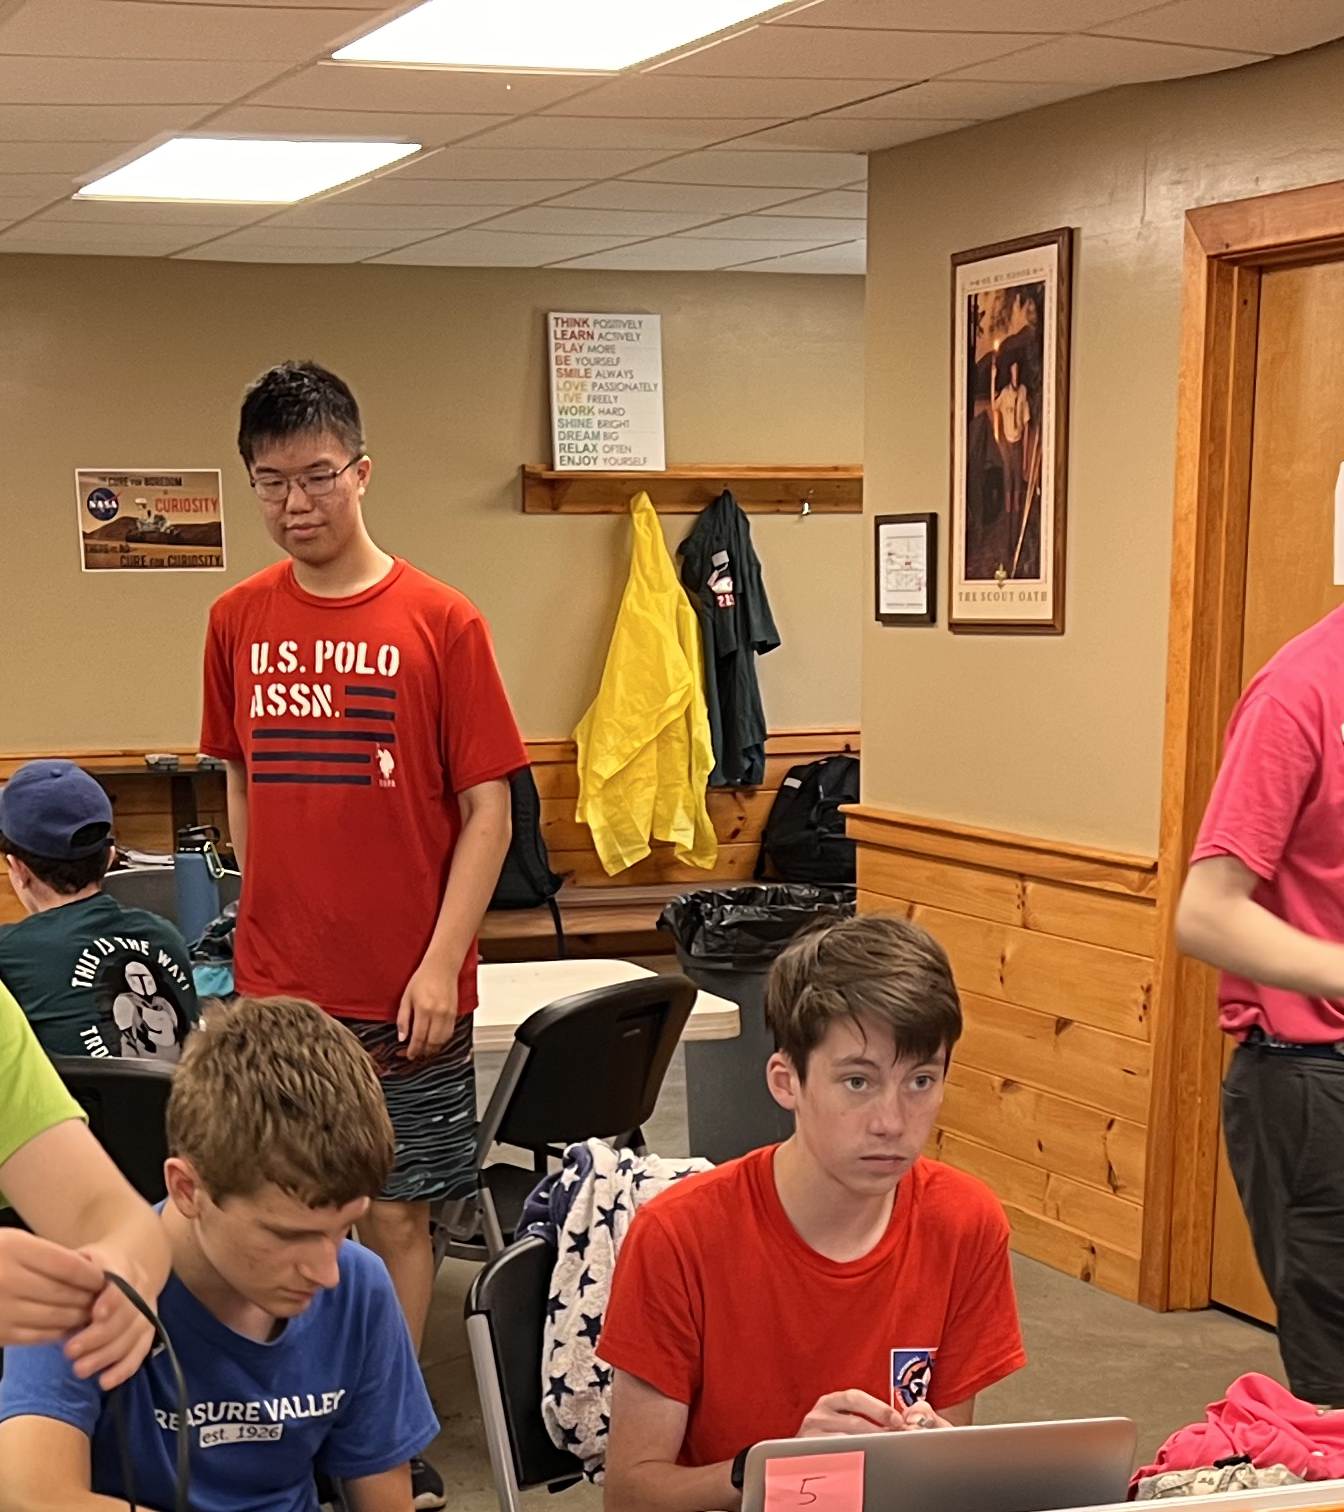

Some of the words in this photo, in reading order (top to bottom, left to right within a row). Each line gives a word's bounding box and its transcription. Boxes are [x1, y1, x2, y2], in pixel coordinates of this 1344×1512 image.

[554, 317, 590, 328] THINK
[593, 319, 644, 329] POSITIVELY
[554, 330, 594, 341] LEARN
[597, 331, 641, 342] ACTIVELY
[555, 343, 584, 353] PLAY
[587, 344, 616, 354] MORE
[555, 355, 571, 366] BE
[575, 356, 621, 366] YOURSELF
[556, 368, 592, 379] SMILE
[595, 369, 635, 379] ALWAYS
[557, 381, 588, 391] LOVE
[592, 382, 658, 392] PASSIONATELY
[557, 393, 583, 404] LIVE
[587, 394, 619, 404] FREELY
[558, 406, 595, 416] WORK
[598, 407, 626, 417] HARD
[558, 418, 593, 429] SHINE
[597, 419, 630, 429] BRIGHT
[558, 431, 601, 441] DREAM
[603, 432, 619, 442] BIG
[559, 443, 598, 454] RELAX
[602, 444, 632, 454] OFTEN
[559, 455, 599, 466] ENJOY
[602, 457, 648, 467] YOURSELF
[88, 499, 119, 513] NASA
[155, 498, 219, 513] CURIOSITY
[120, 555, 147, 567] CURE
[167, 555, 222, 567] CURIOSITY
[959, 591, 977, 602] THE
[981, 591, 1014, 602] SCOUT
[1019, 591, 1048, 602] OATH
[251, 640, 306, 675] U.S.
[314, 640, 400, 677] POLO
[250, 683, 341, 718] ASSN.
[71, 948, 101, 988] THIS
[93, 937, 116, 956] IS
[113, 936, 150, 956] THE
[264, 1389, 346, 1422] VALLEY
[203, 1429, 230, 1444] est.
[236, 1425, 280, 1440] 1926
[798, 1476, 827, 1506] 5
